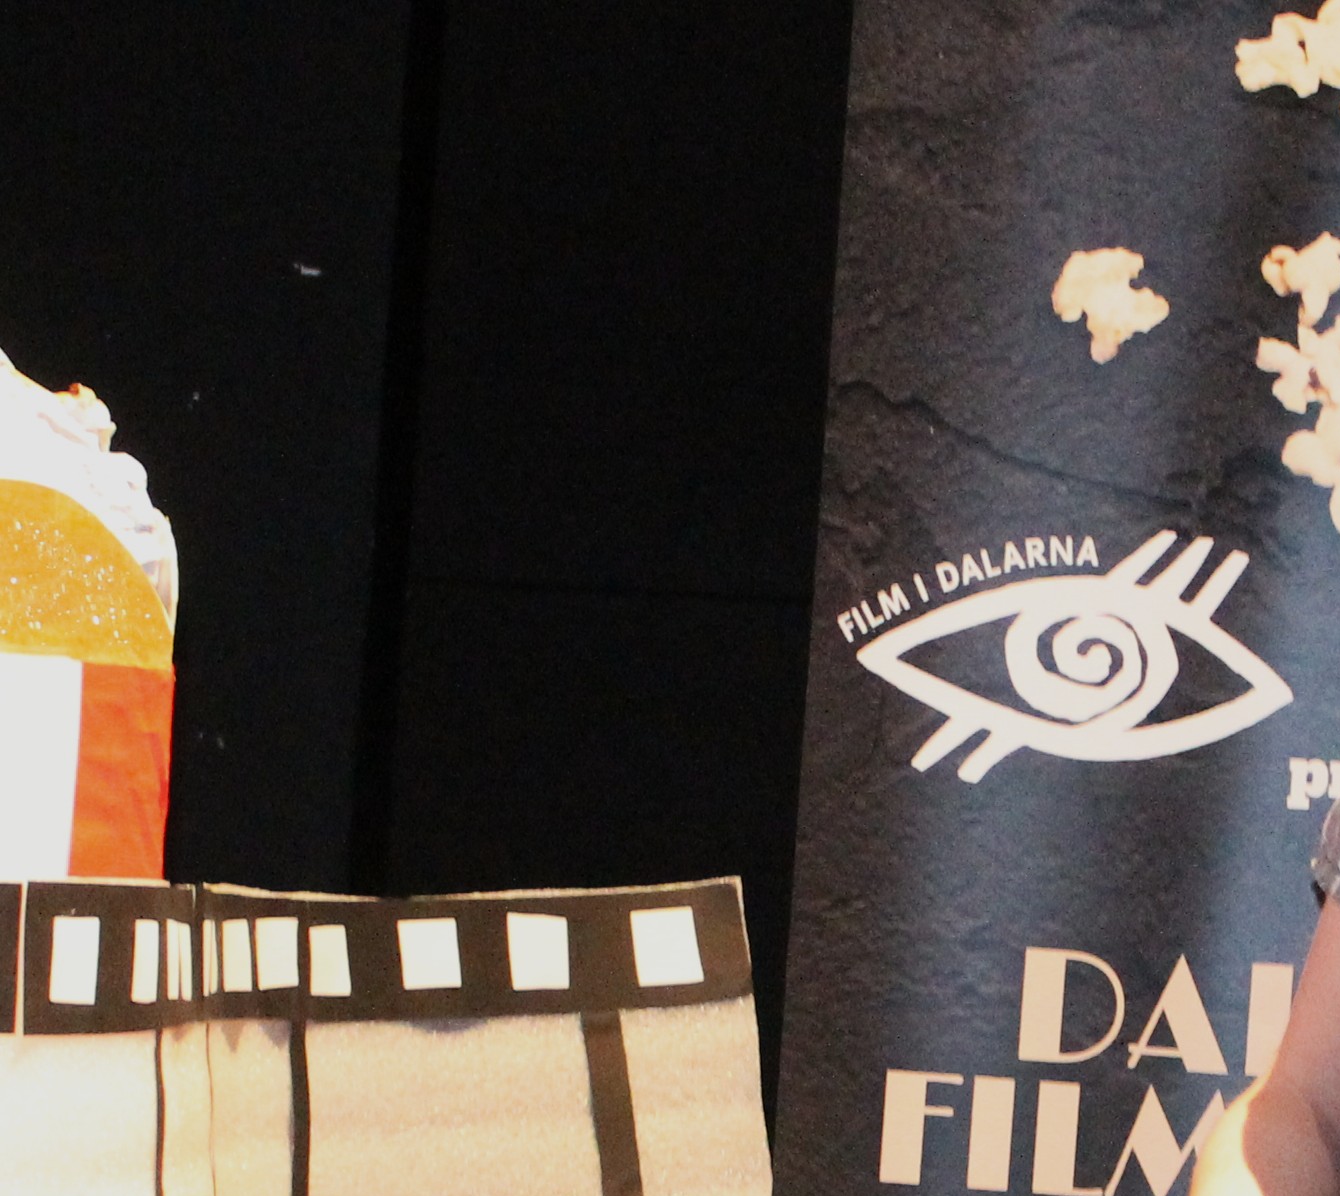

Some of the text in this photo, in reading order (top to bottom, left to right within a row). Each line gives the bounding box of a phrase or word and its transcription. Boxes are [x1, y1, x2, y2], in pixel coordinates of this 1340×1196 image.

[837, 535, 1099, 643] FILM I DALARNA
